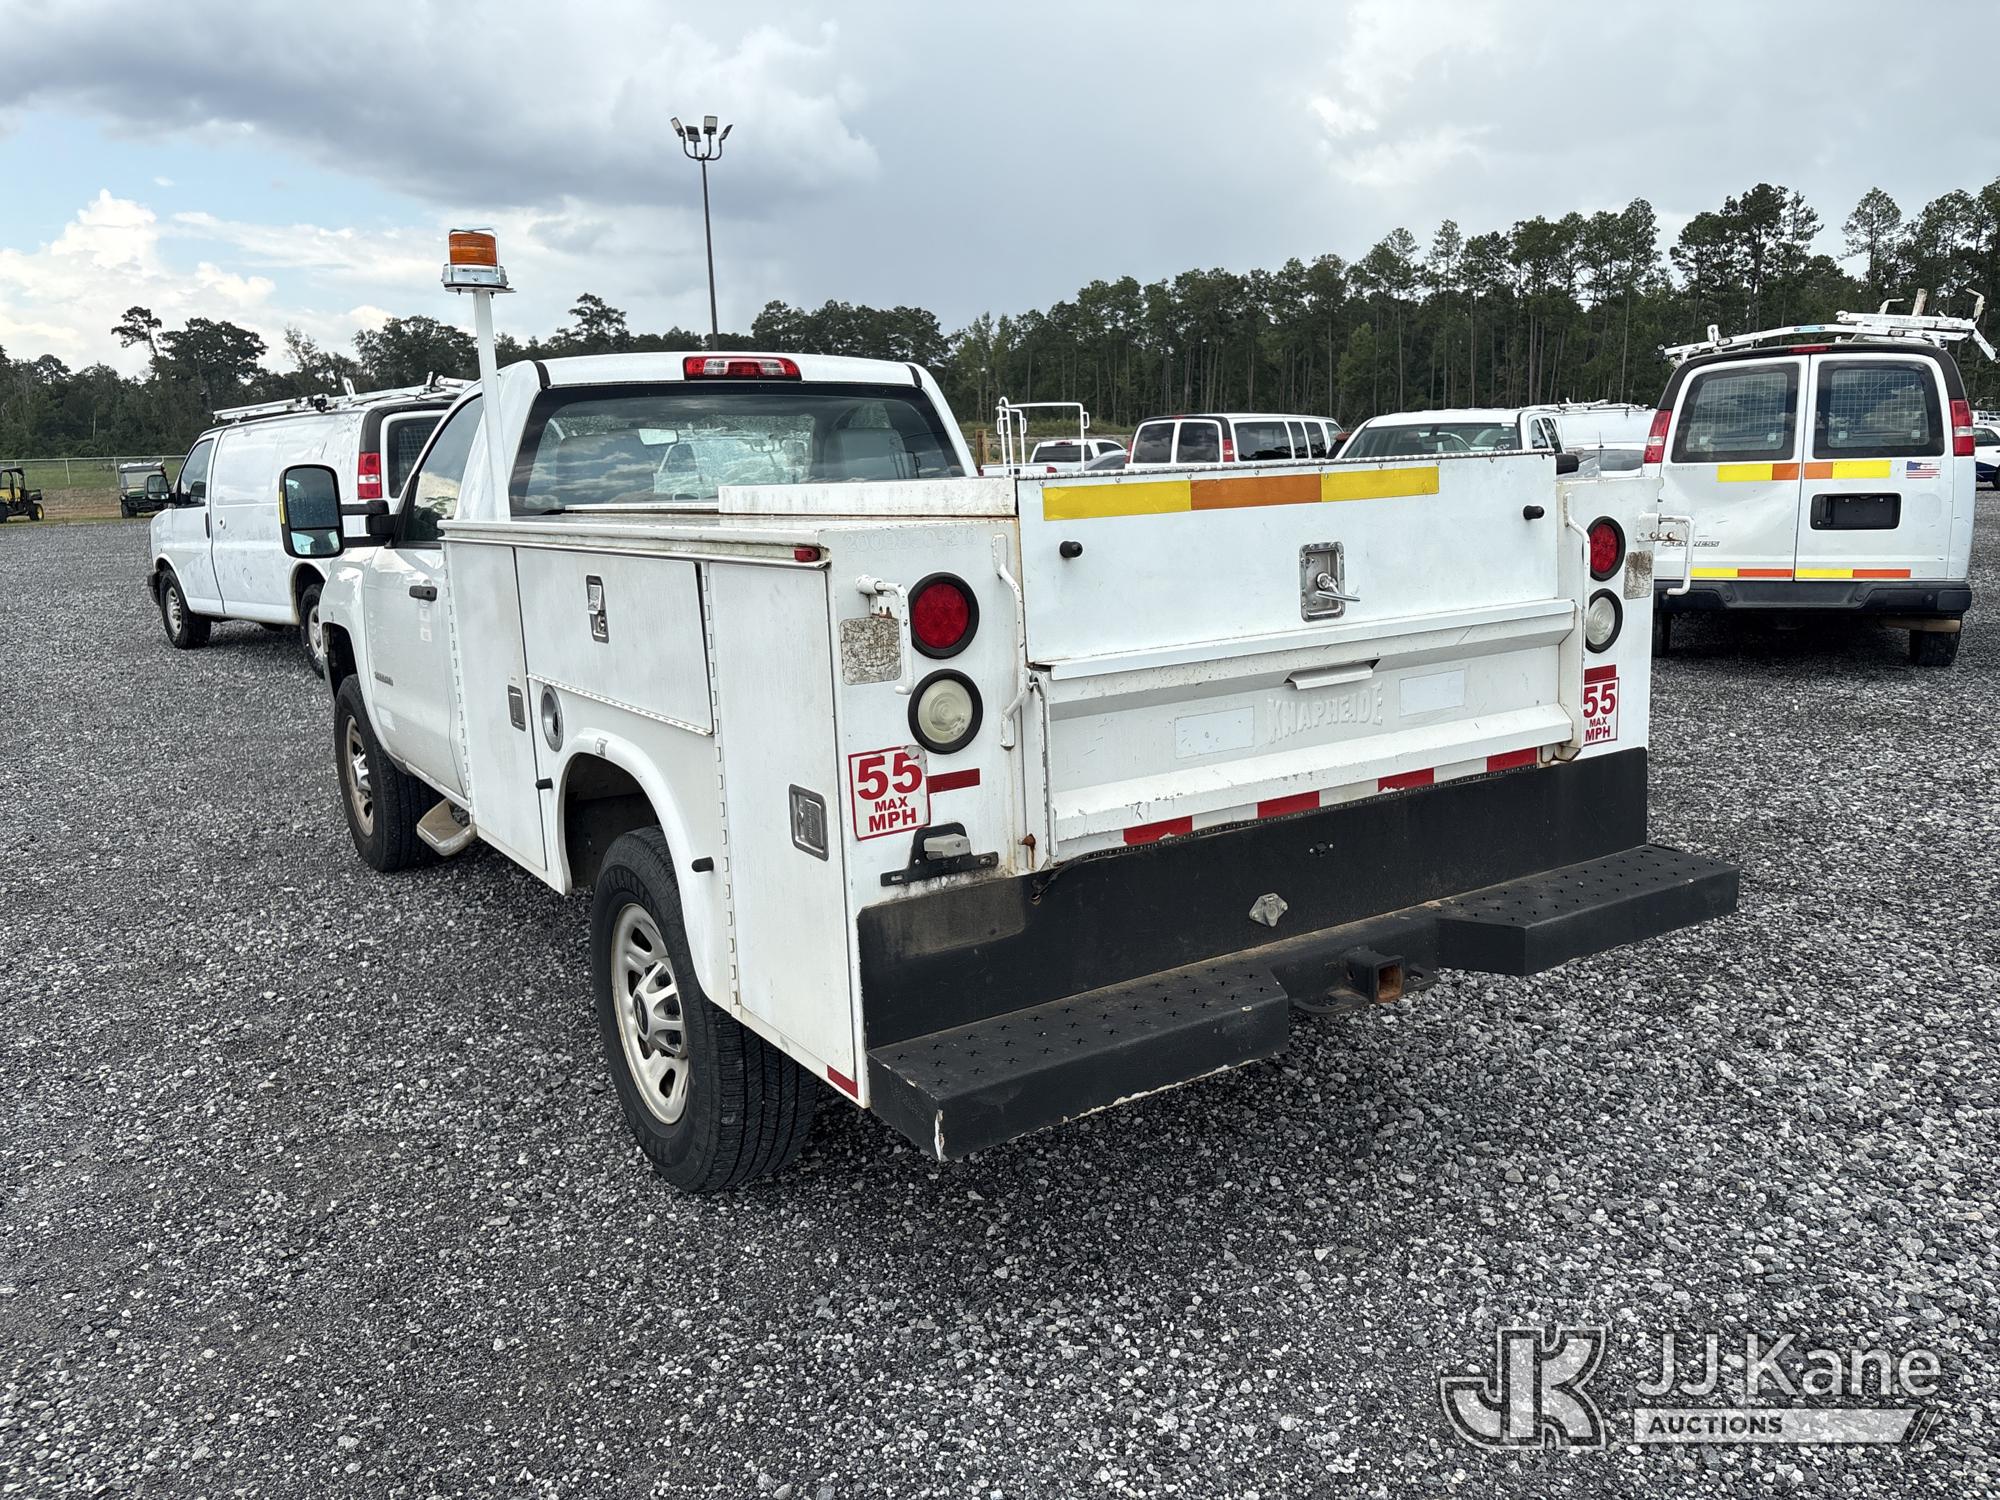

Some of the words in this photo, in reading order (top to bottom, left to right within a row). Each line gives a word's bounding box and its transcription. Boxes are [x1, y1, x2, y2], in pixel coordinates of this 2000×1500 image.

[1583, 682, 1616, 718] 55
[1266, 681, 1383, 744] KNAPHEIDE
[1589, 716, 1608, 727] MAX
[1585, 725, 1611, 742] MPH
[857, 752, 923, 800] 55
[874, 796, 908, 813] MAX
[868, 808, 917, 832] MPH
